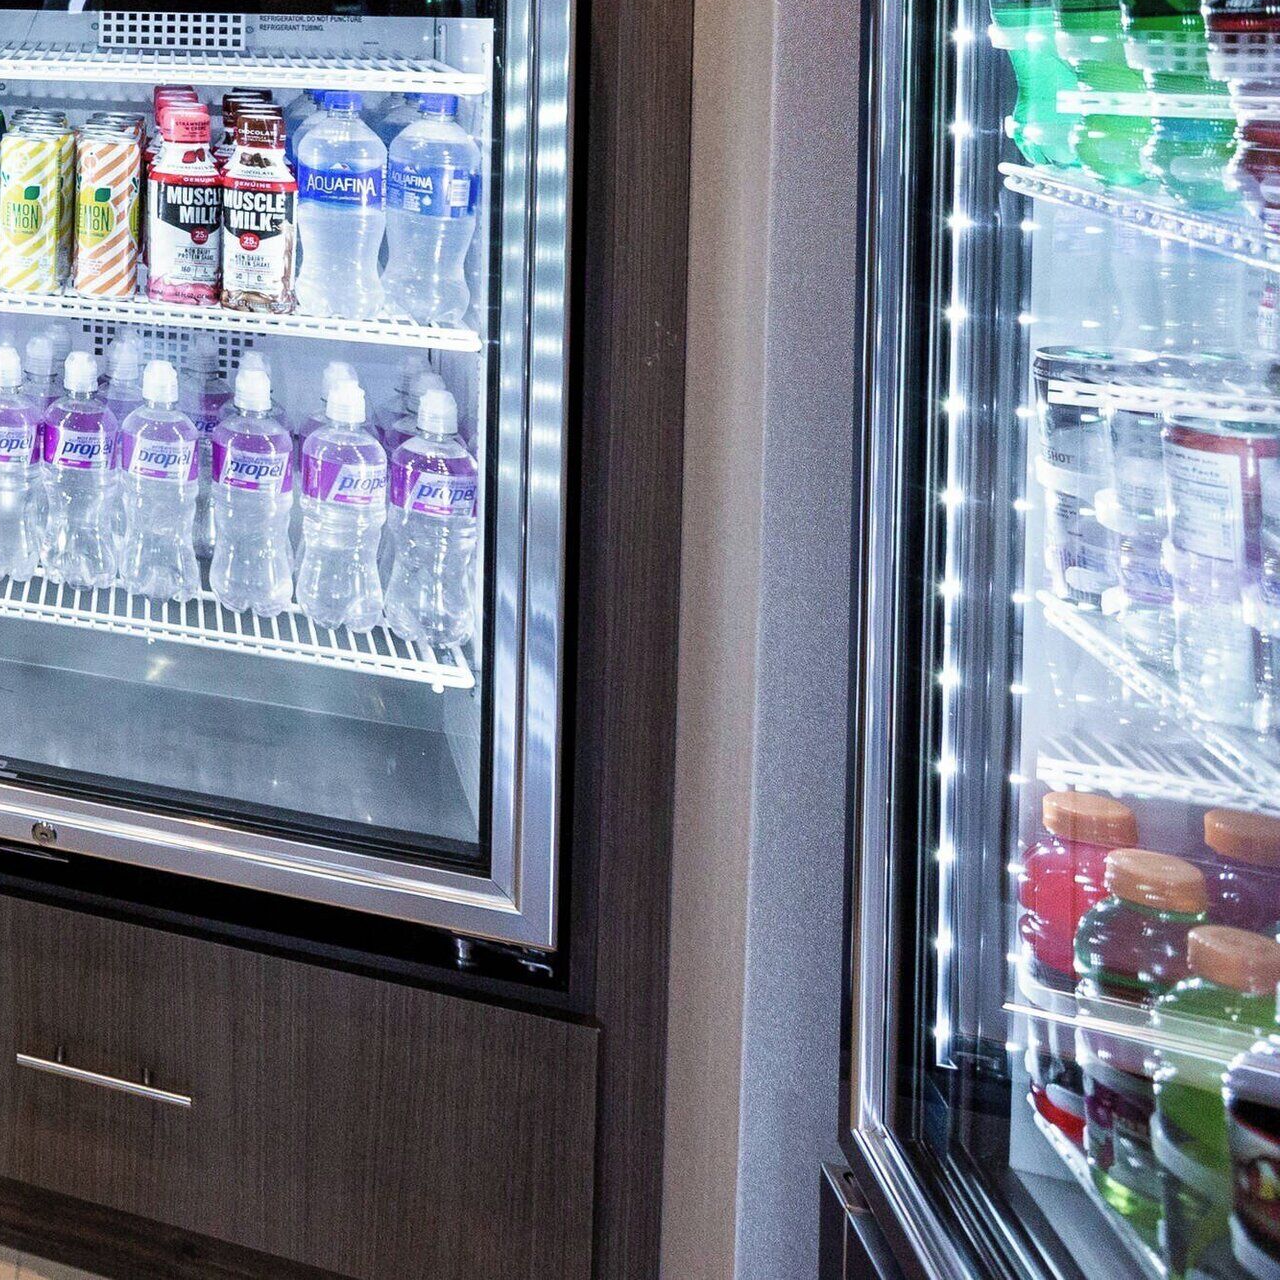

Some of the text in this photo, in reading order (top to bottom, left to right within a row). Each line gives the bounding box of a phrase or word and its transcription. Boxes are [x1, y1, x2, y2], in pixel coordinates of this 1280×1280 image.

[306, 173, 377, 197] AQUAFINA
[391, 170, 434, 191] AQUAFINA
[224, 189, 287, 212] MUSCLE
[179, 205, 218, 224] MILK
[230, 212, 274, 231] MILK
[252, 260, 270, 269] SHAKE
[62, 438, 112, 459] propel
[139, 449, 190, 468] propel
[229, 459, 284, 480] propel
[416, 482, 476, 503] propel
